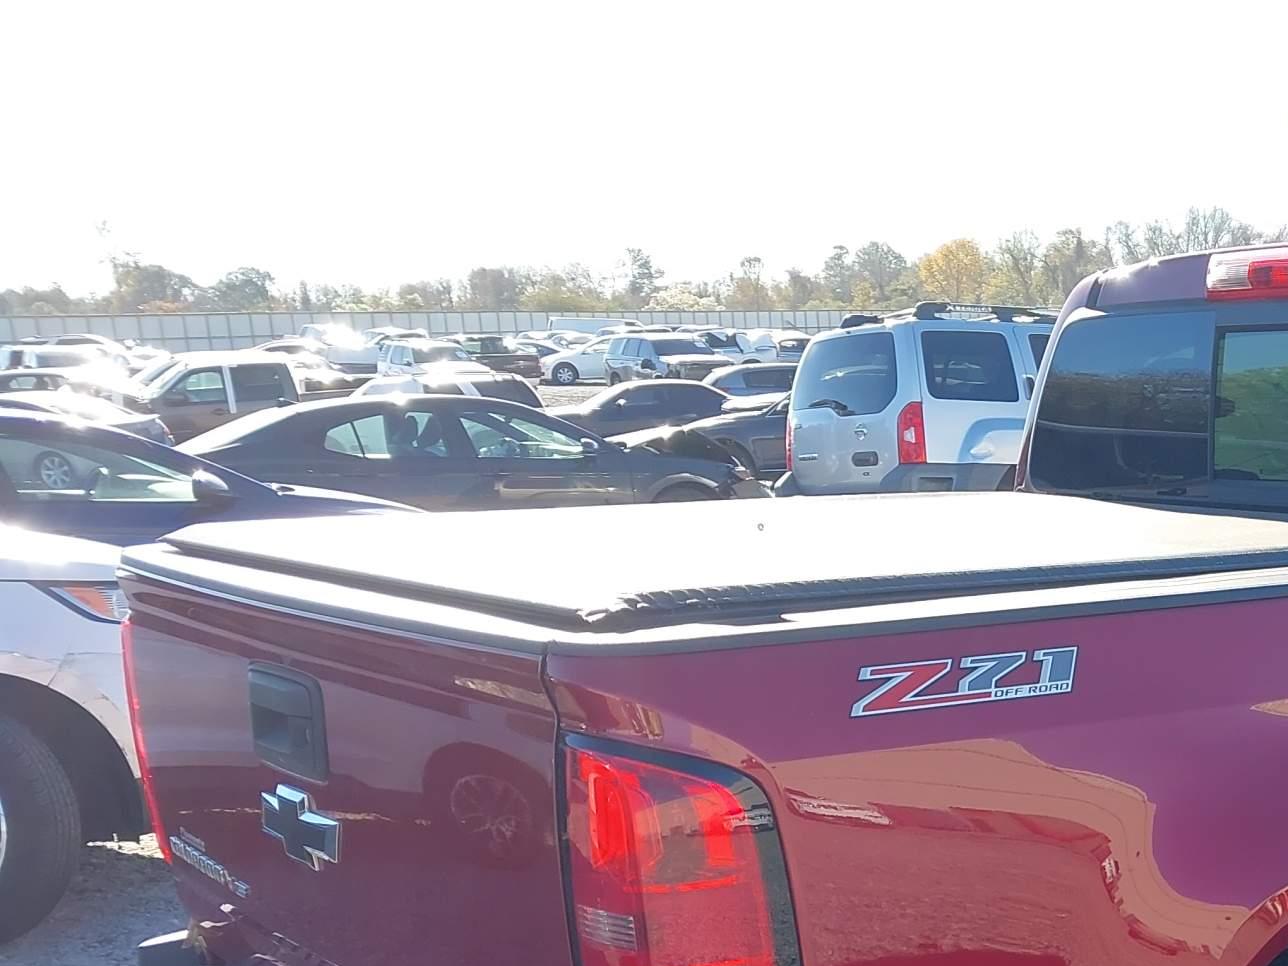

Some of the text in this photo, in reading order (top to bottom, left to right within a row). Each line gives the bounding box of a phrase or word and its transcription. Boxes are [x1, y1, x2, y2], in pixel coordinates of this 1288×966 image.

[850, 645, 1079, 717] Z71
[994, 682, 1070, 698] OFF ROAD
